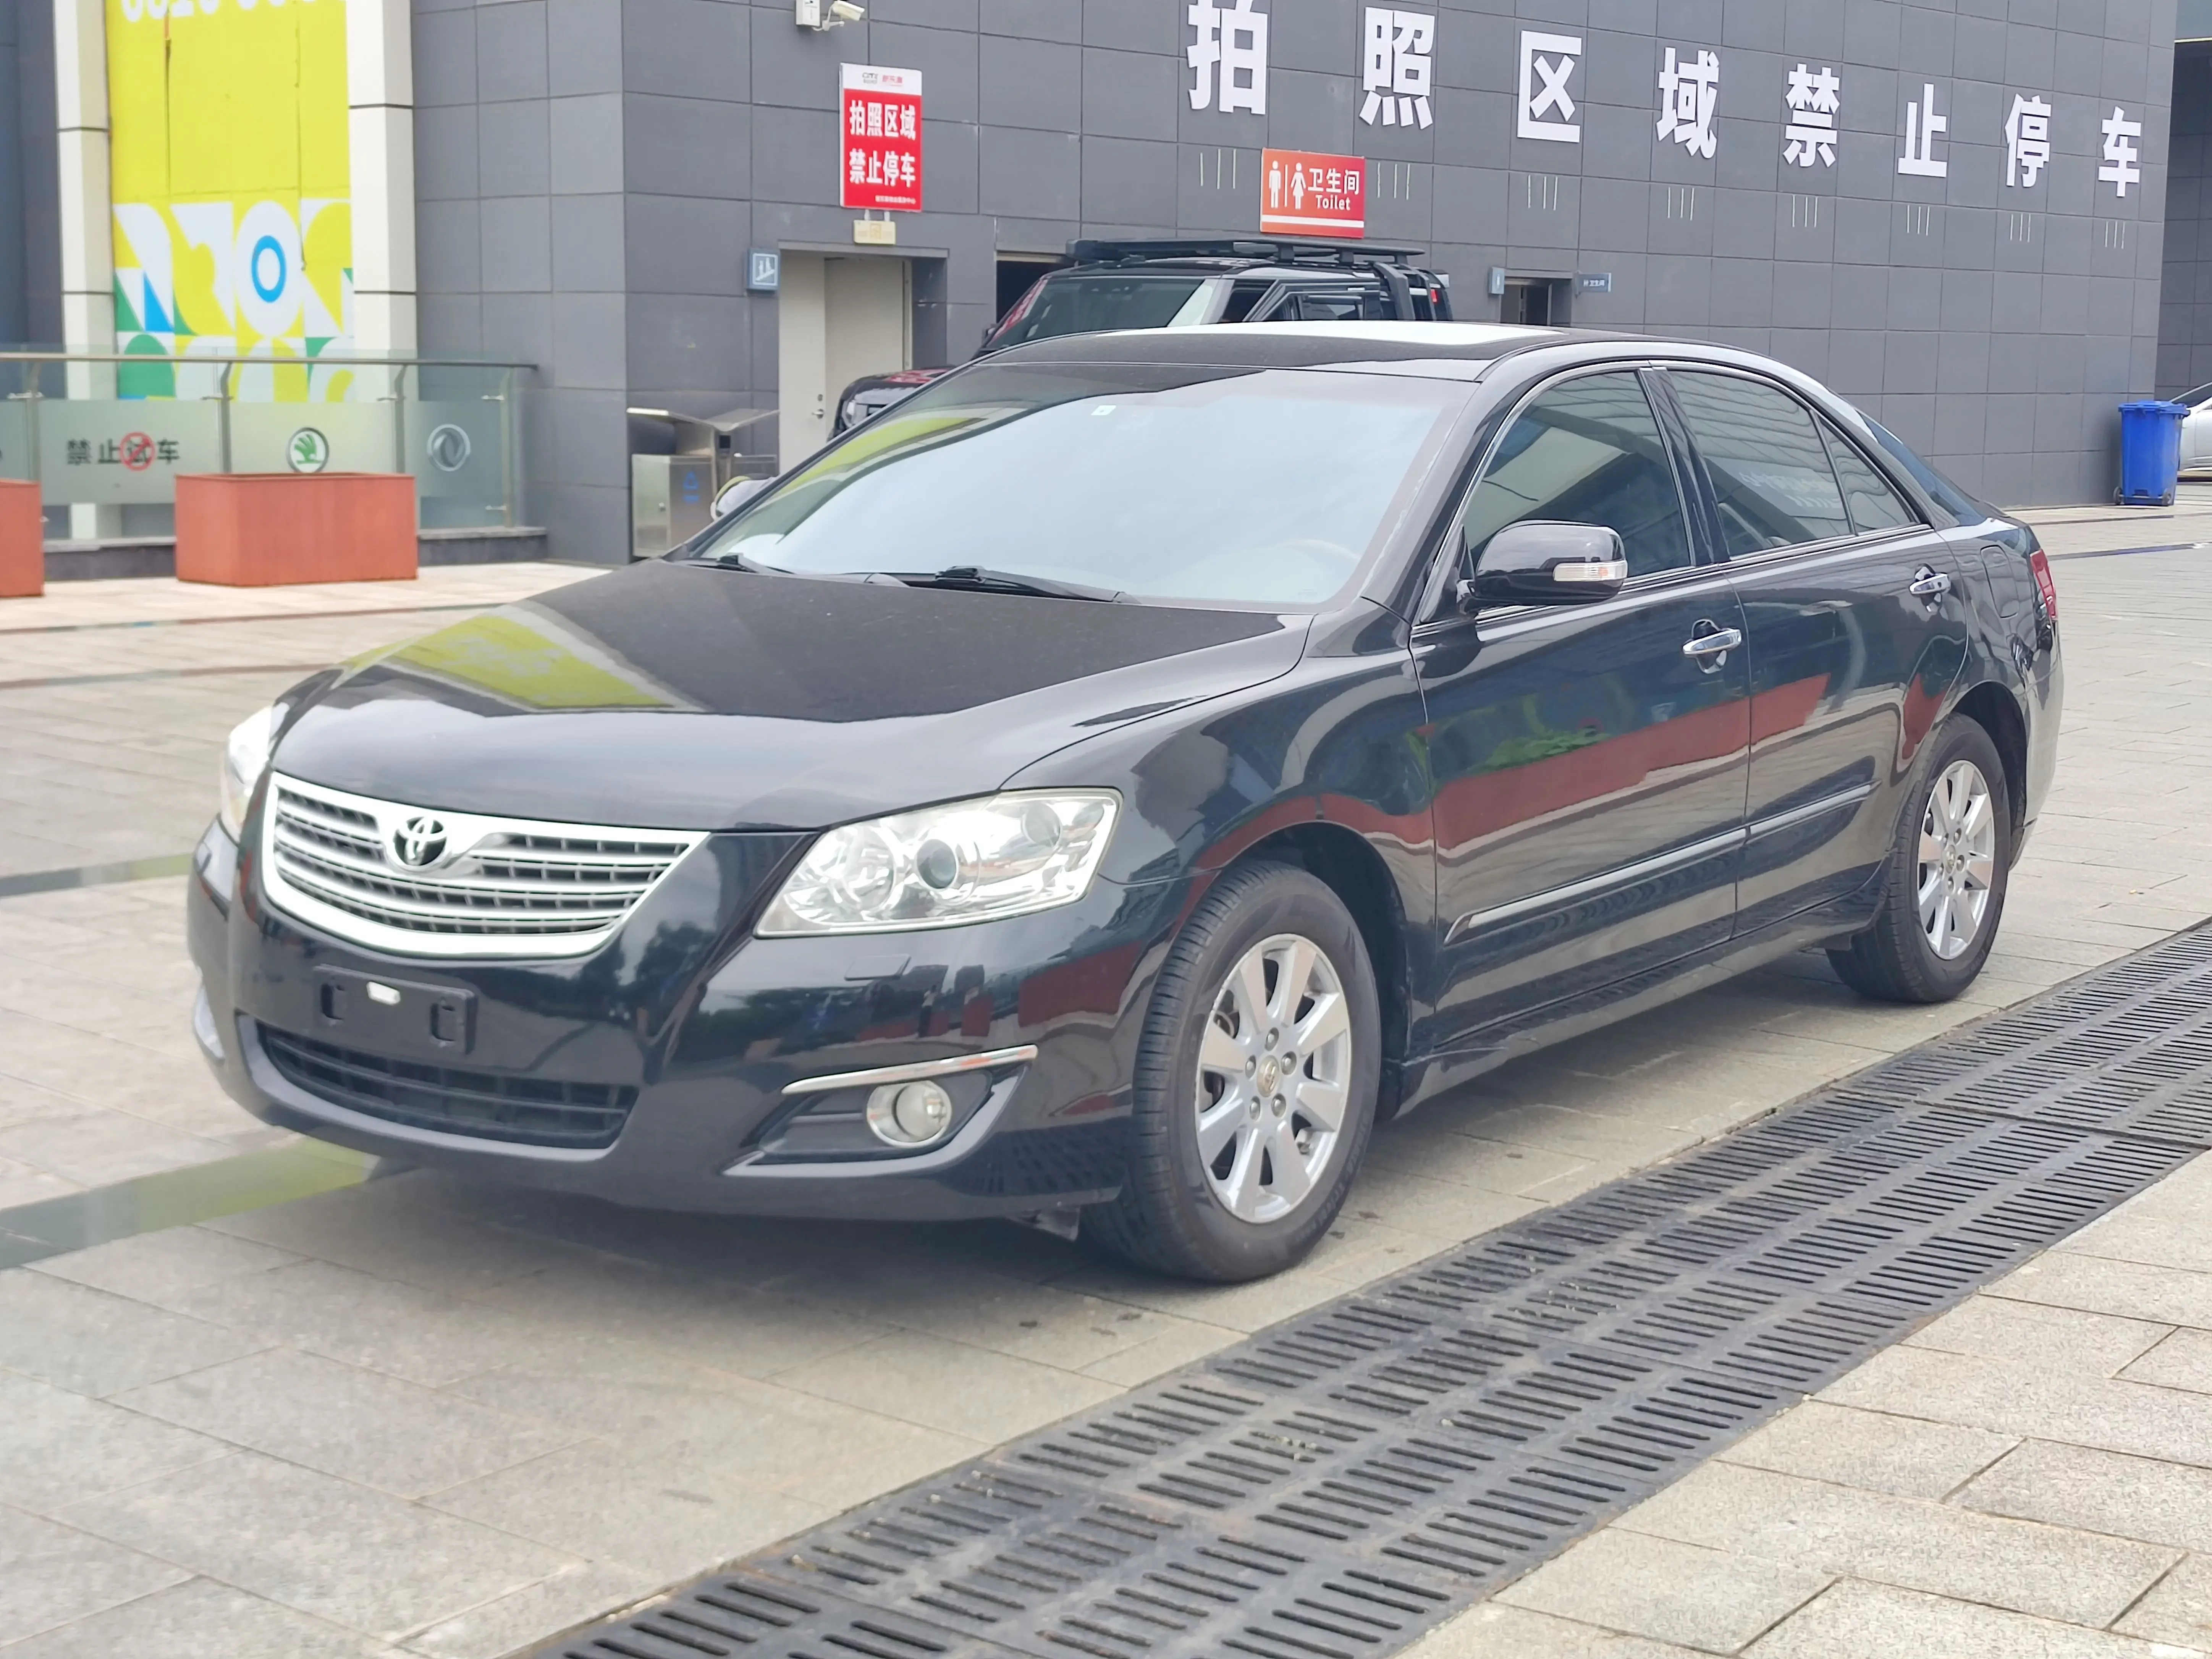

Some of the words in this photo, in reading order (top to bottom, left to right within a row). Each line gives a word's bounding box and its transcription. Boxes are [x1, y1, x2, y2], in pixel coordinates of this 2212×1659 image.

[849, 99, 916, 141] 拍照区域
[849, 148, 916, 188] 禁止停车
[1307, 168, 1360, 196] 卫生间
[1315, 194, 1351, 210] Toilet
